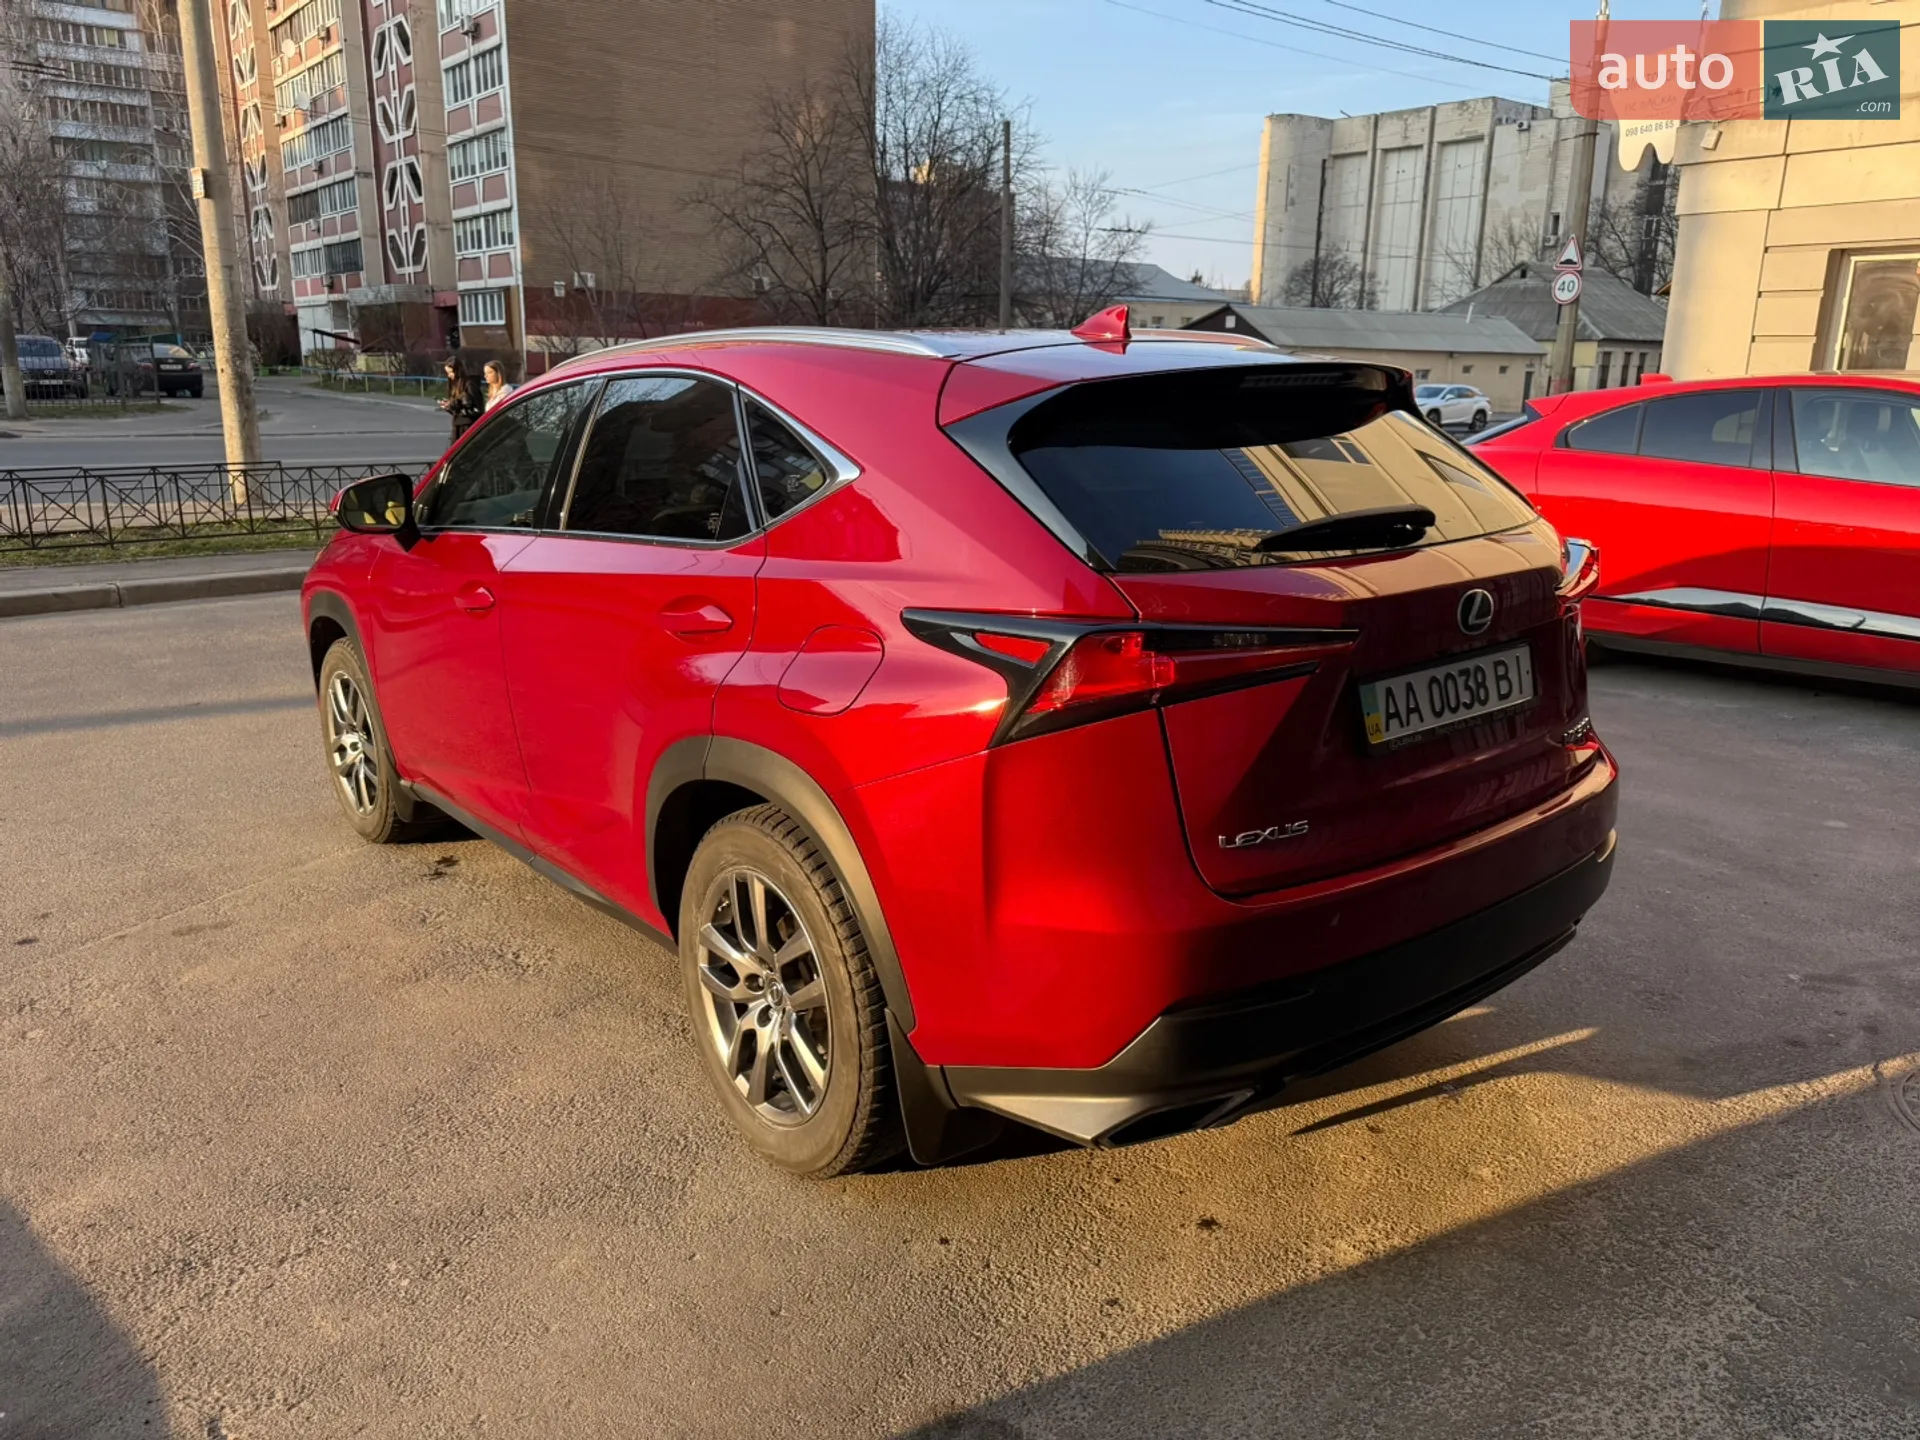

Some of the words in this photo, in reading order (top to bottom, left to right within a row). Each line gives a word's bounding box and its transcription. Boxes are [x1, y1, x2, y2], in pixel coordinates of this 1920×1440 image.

[1557, 280, 1576, 293] 40
[1384, 681, 1424, 733] AA
[1427, 663, 1490, 718] 0038
[1368, 722, 1382, 736] UA
[1218, 820, 1309, 848] LEXUS
